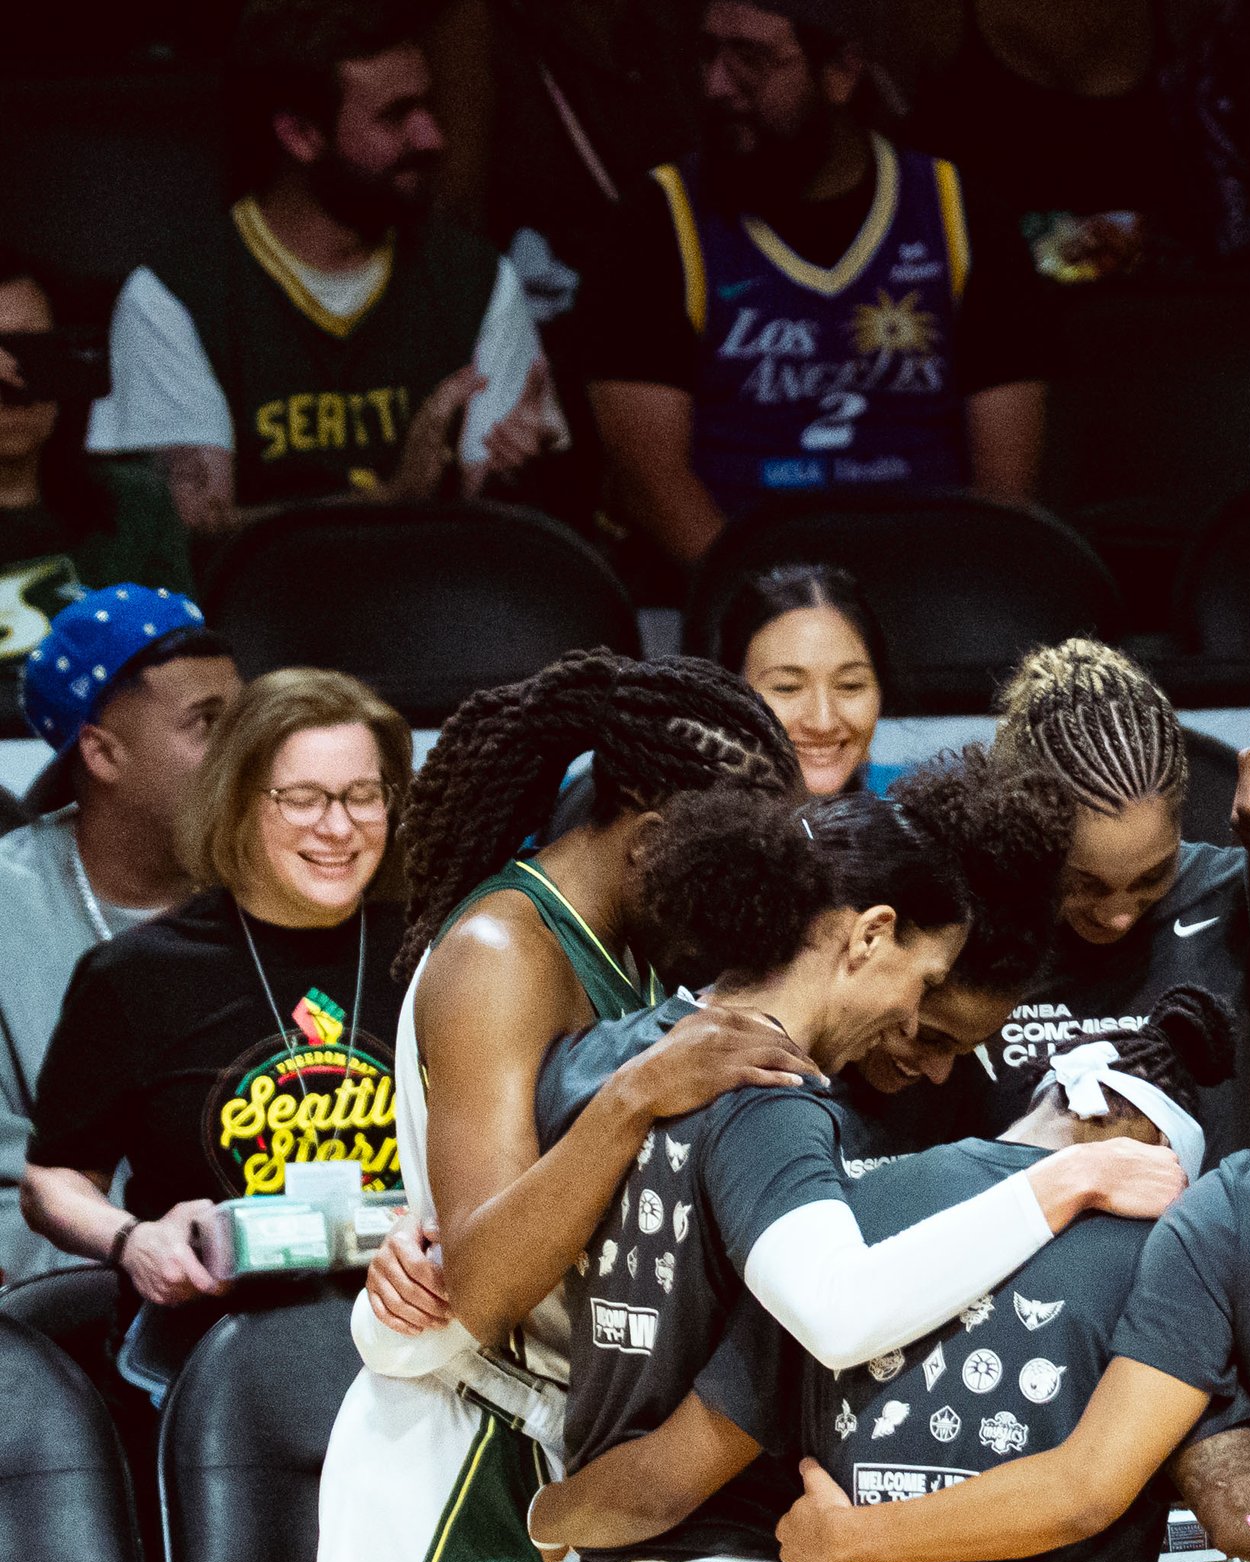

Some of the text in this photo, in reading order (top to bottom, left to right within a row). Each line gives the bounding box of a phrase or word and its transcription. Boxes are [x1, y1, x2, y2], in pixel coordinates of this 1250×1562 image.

[800, 390, 869, 450] 2
[220, 1075, 396, 1149] Seattl
[858, 1470, 927, 1493] WELCOME
[858, 1490, 881, 1505] TO
